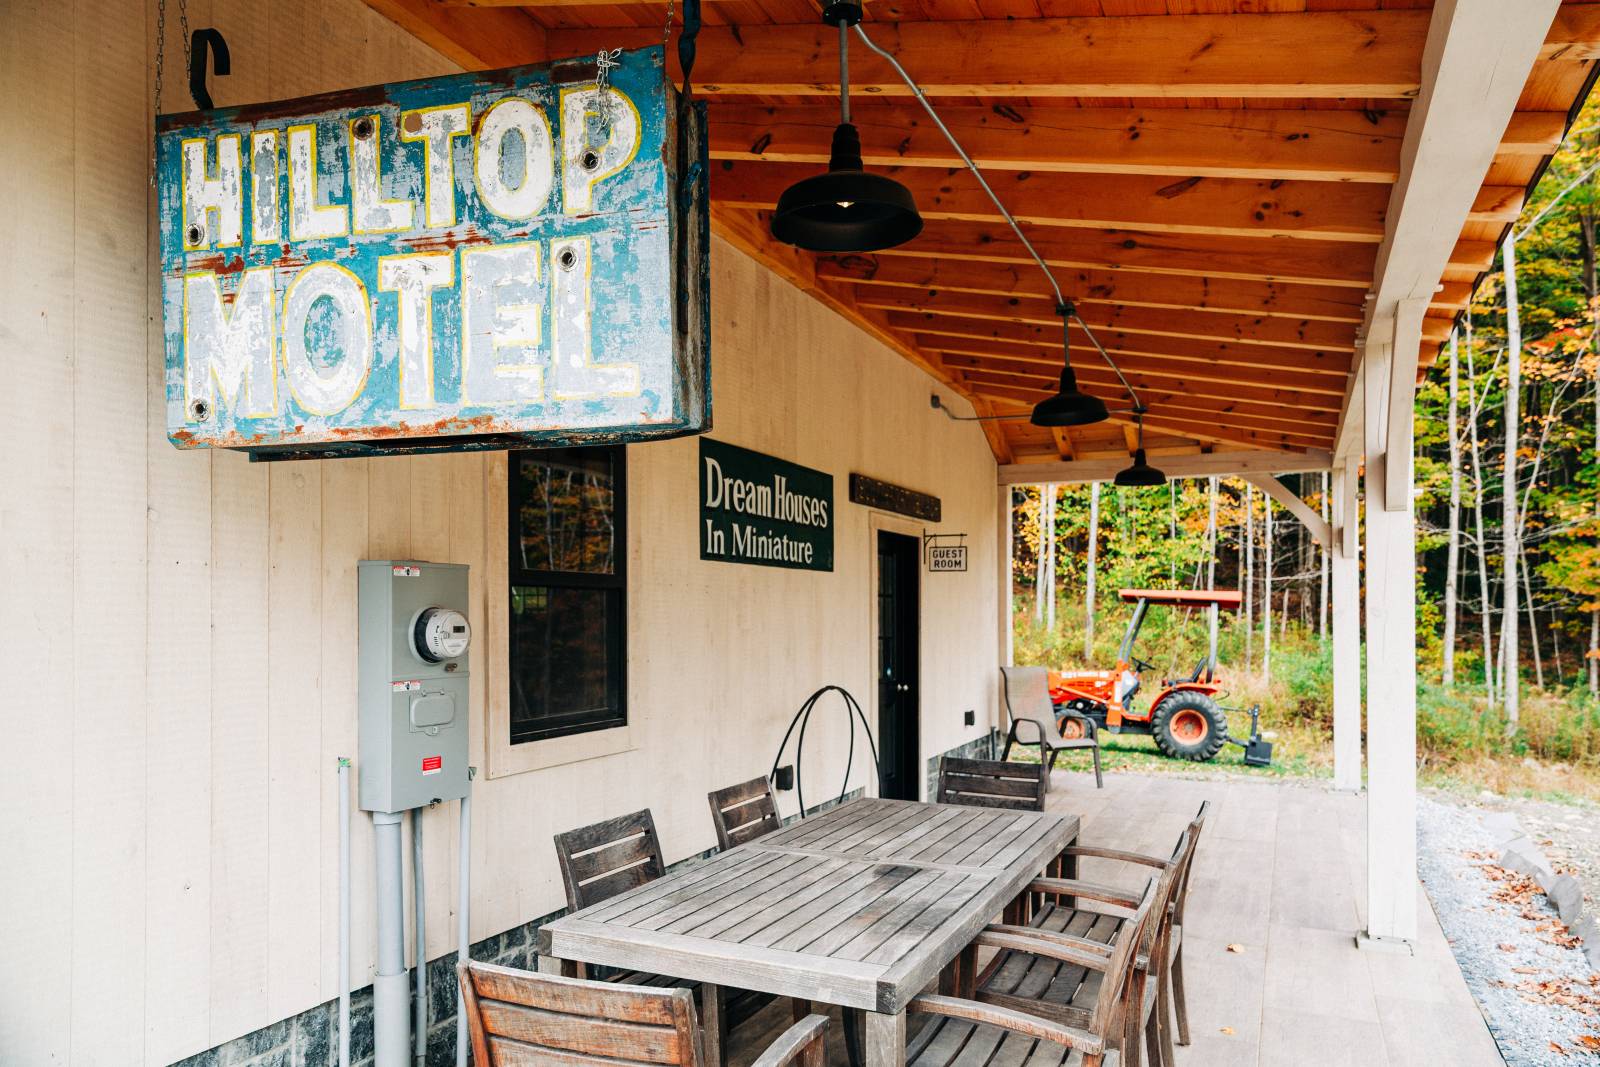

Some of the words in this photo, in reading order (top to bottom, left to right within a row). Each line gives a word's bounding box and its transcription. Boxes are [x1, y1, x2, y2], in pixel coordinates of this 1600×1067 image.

[182, 86, 642, 251] HILLTOP
[183, 237, 640, 420] MOTEL
[704, 457, 773, 518] Dream
[774, 474, 828, 528] Houses
[706, 519, 725, 555] In
[731, 523, 813, 564] Miniature
[932, 549, 963, 559] GUEST
[933, 559, 962, 569] ROOM
